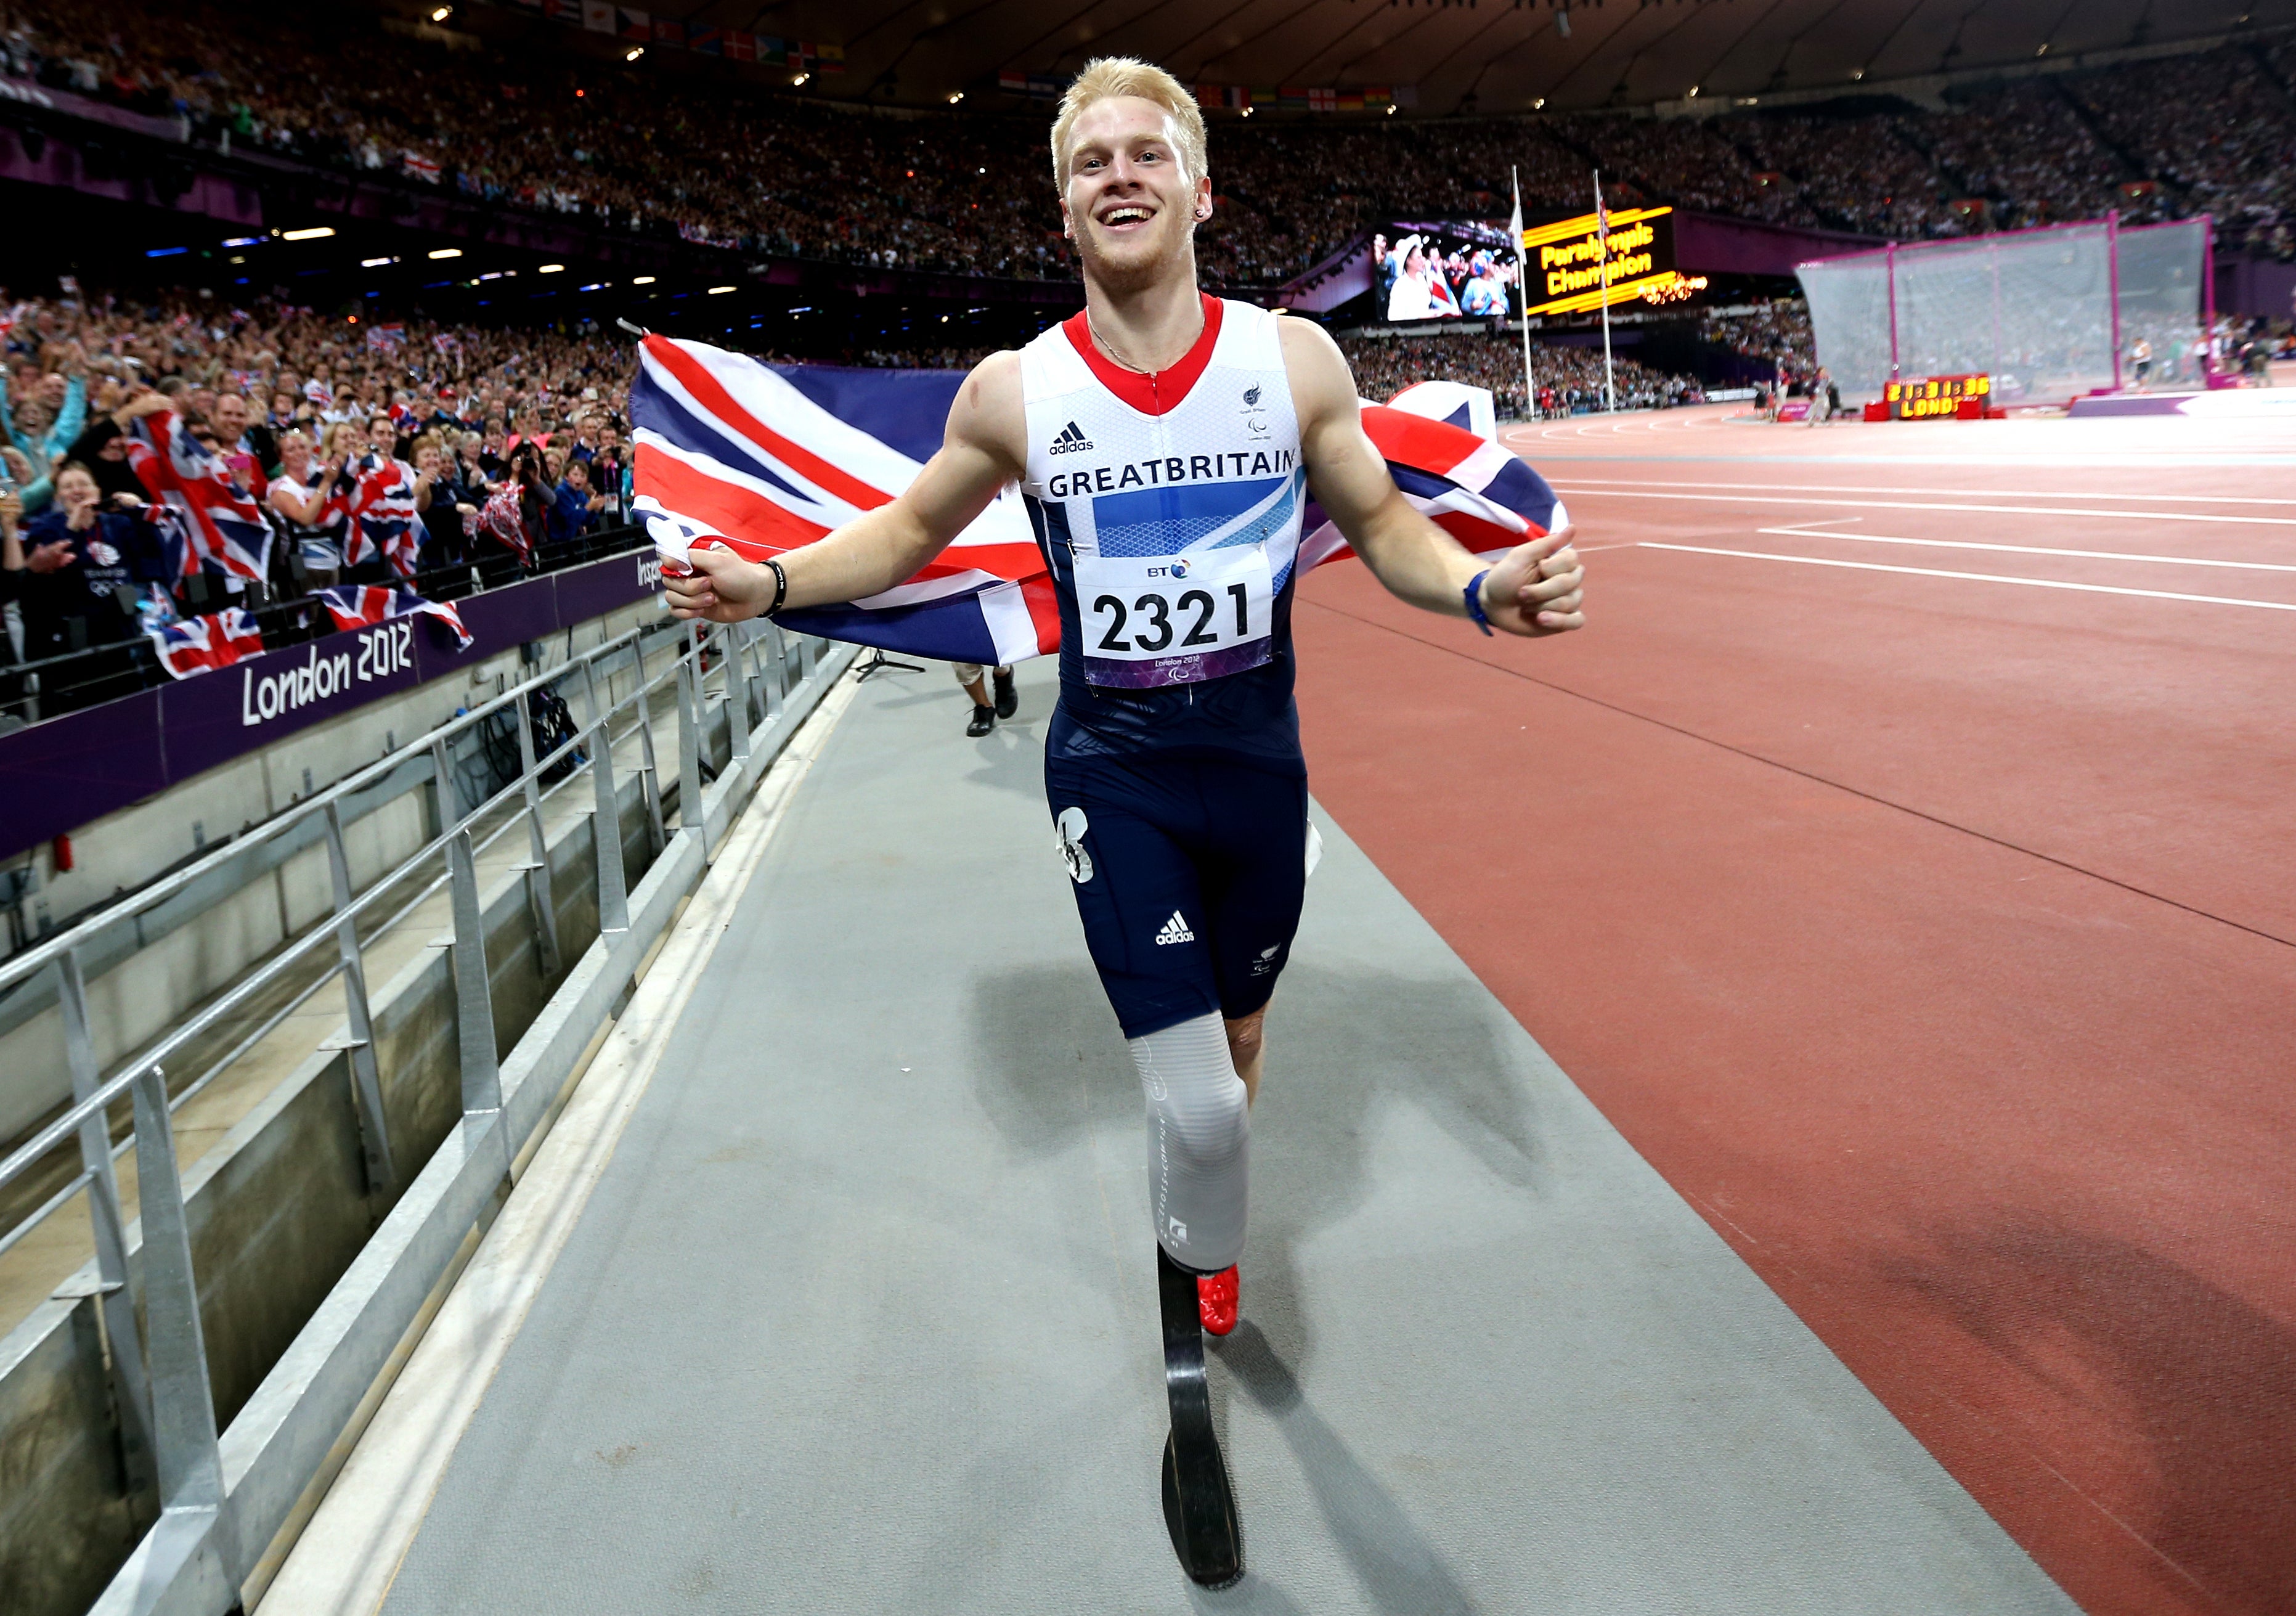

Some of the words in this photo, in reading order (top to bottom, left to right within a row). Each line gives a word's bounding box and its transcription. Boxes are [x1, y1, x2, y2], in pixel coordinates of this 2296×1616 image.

[1541, 221, 1653, 269] Paralympic
[1547, 253, 1651, 296] Champion
[1049, 440, 1093, 455] adidas
[1147, 566, 1169, 577] BT
[1093, 582, 1248, 651] 2321
[243, 644, 351, 726] London
[357, 621, 412, 682] 2012
[1155, 658, 1182, 667] London
[1183, 655, 1200, 664] 2012
[1155, 931, 1194, 945] adidas
